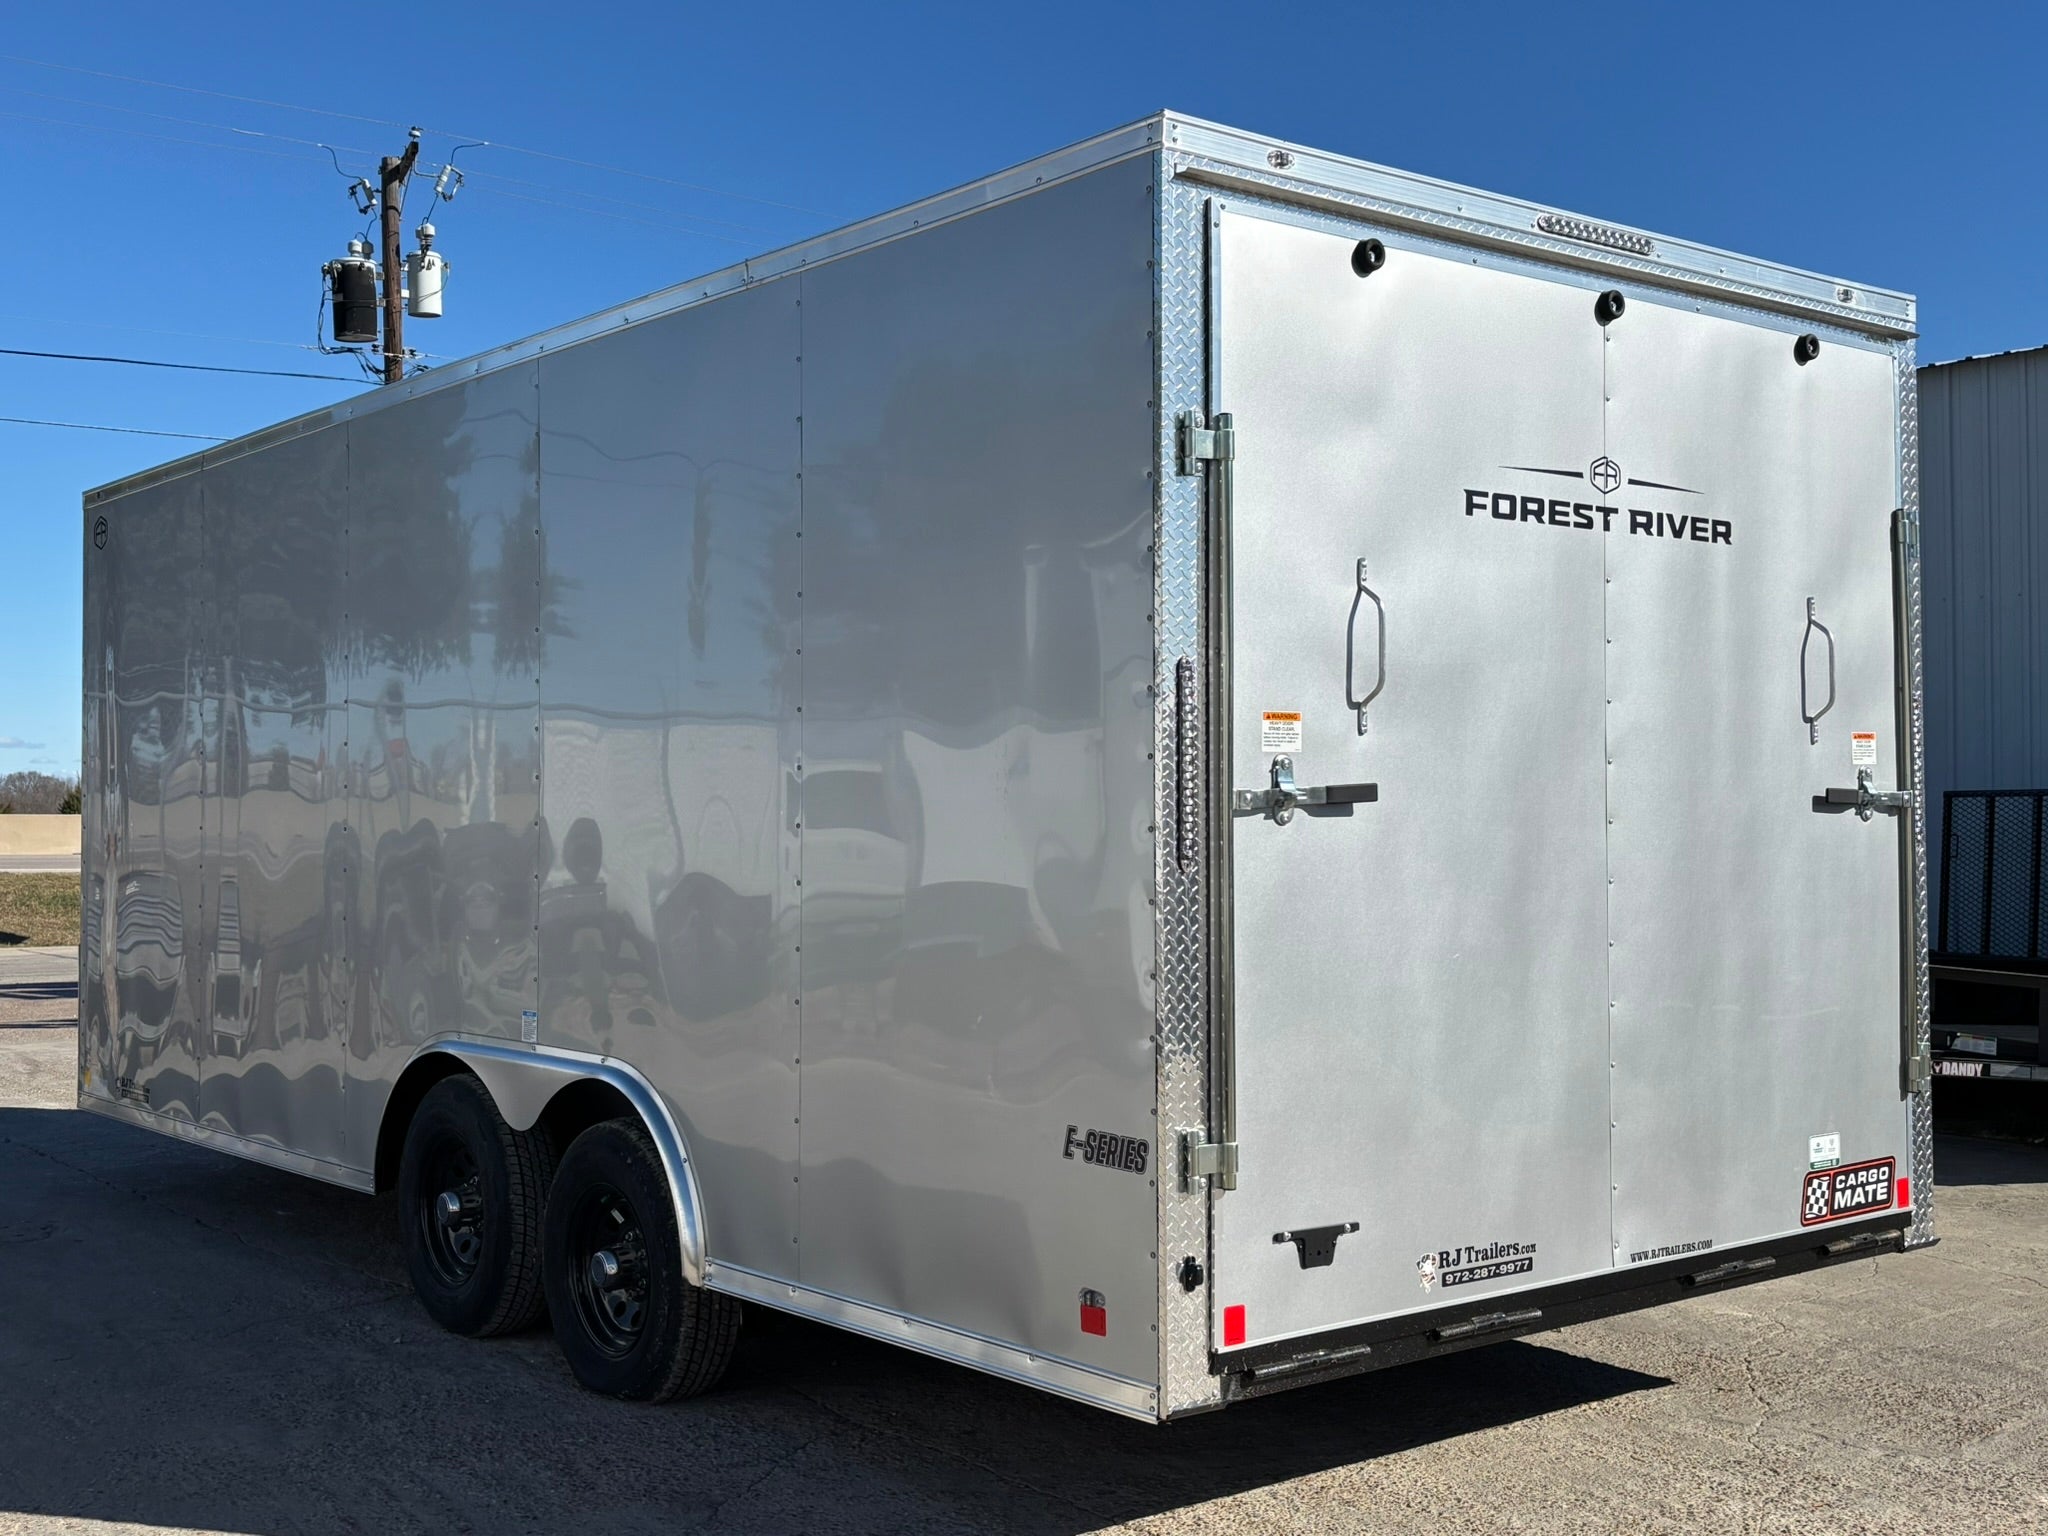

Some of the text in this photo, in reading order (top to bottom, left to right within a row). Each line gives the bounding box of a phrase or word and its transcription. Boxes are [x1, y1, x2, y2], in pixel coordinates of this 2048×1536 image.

[1463, 488, 1732, 545] FOREST RIVER
[1942, 1061, 1983, 1077] DANDY
[1063, 1125, 1149, 1175] E-SERIES
[1836, 1166, 1889, 1189] CARGO
[1834, 1181, 1888, 1210] MATE
[1438, 1248, 1462, 1269] RJ
[1629, 1239, 1713, 1263] WWW.RJTRAILERS.COM
[1445, 1260, 1530, 1284] 972-287-9977
